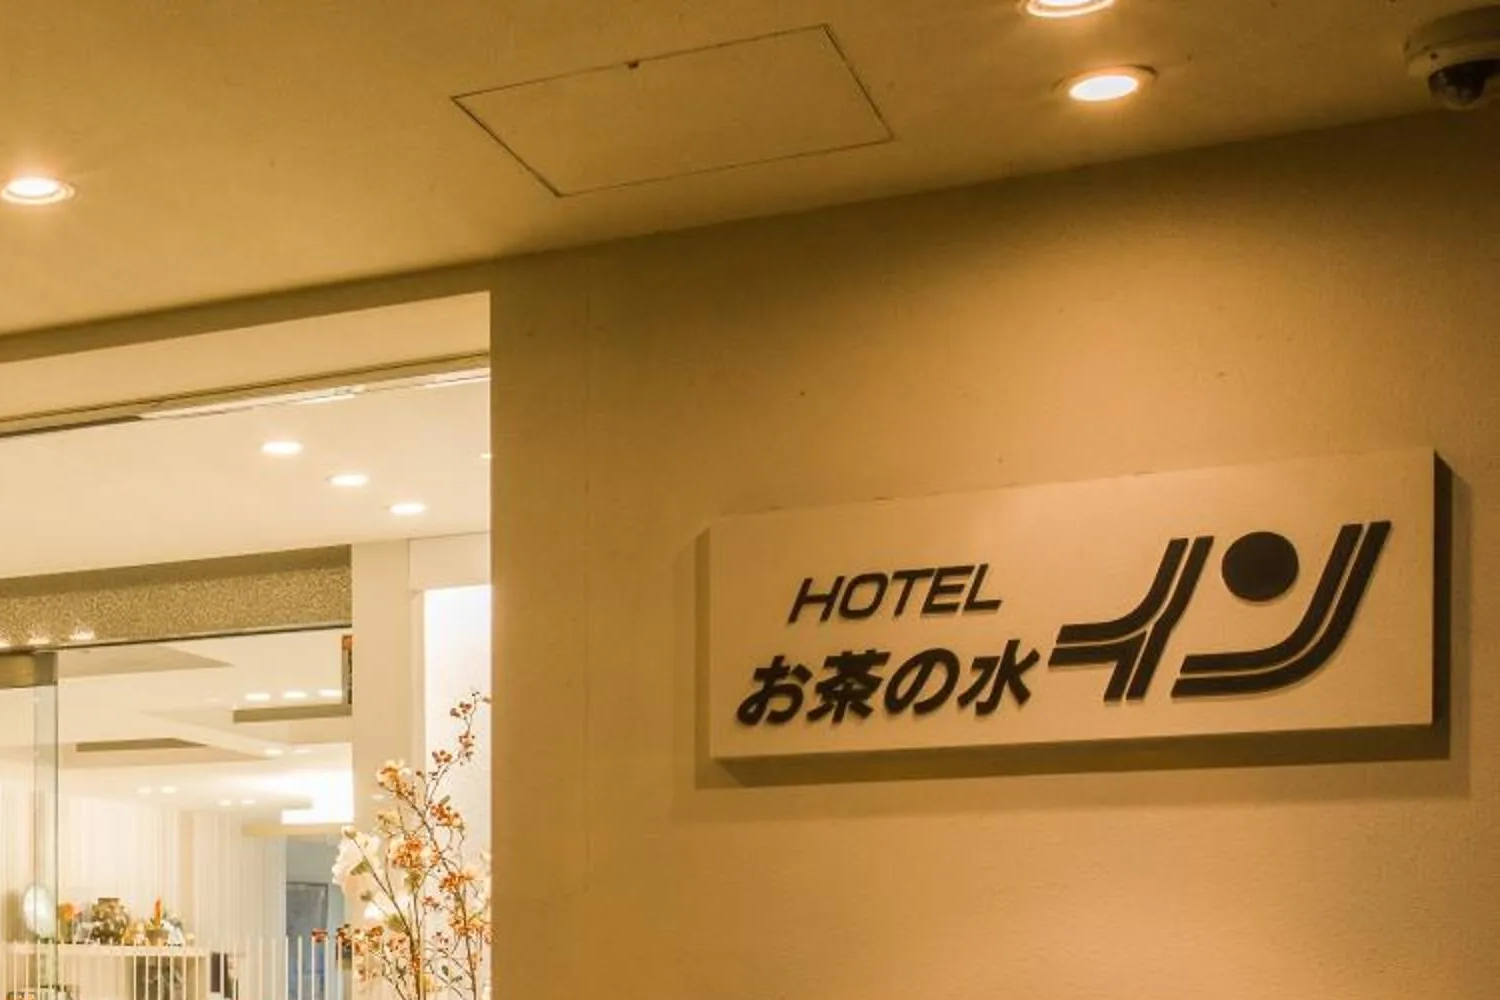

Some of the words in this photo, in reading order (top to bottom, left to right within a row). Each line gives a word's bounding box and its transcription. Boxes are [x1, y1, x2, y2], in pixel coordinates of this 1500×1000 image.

[787, 564, 1002, 624] HOTEL
[736, 639, 1040, 727] お茶の水
